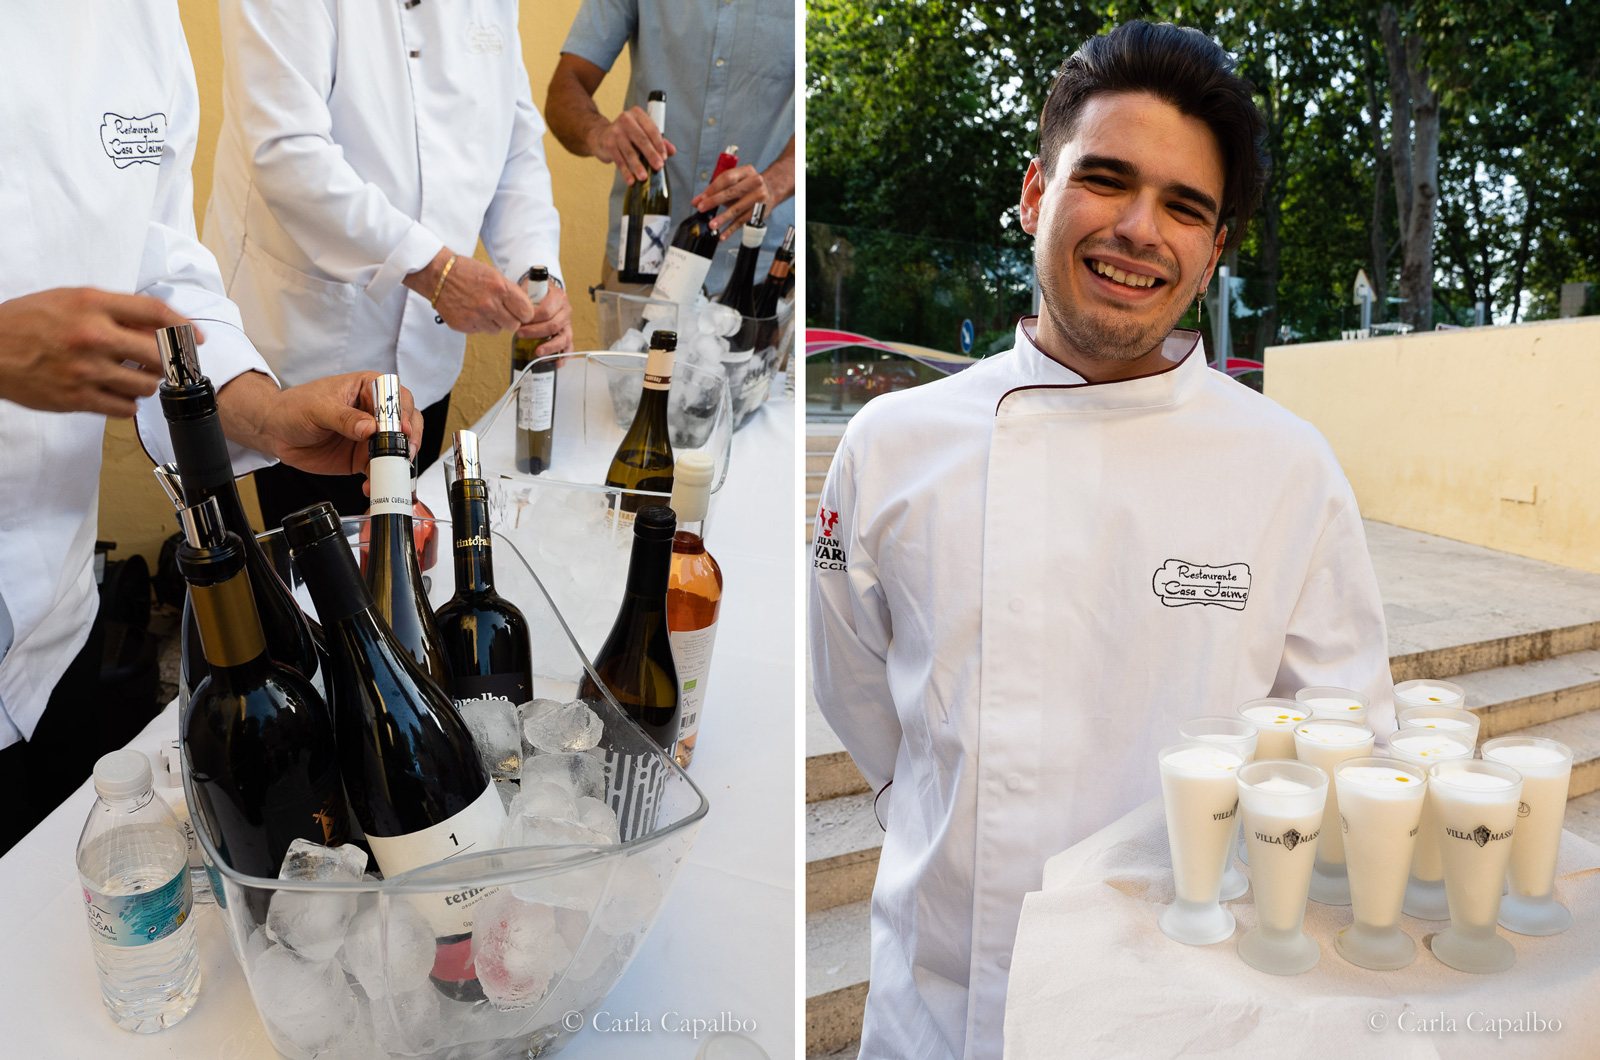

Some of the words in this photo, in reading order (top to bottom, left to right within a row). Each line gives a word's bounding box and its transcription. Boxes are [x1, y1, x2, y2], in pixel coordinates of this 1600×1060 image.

[114, 119, 158, 134] Restaurante
[110, 138, 133, 155] Casa
[136, 135, 163, 154] Jaim
[816, 545, 847, 562] VAR
[1177, 565, 1237, 581] Restaurante
[1162, 581, 1196, 597] Casa
[1204, 581, 1248, 599] Jaime
[449, 832, 459, 846] 1
[1255, 831, 1282, 844] VILLA
[1446, 827, 1473, 841] VILLA
[461, 895, 484, 910] ORGANIC
